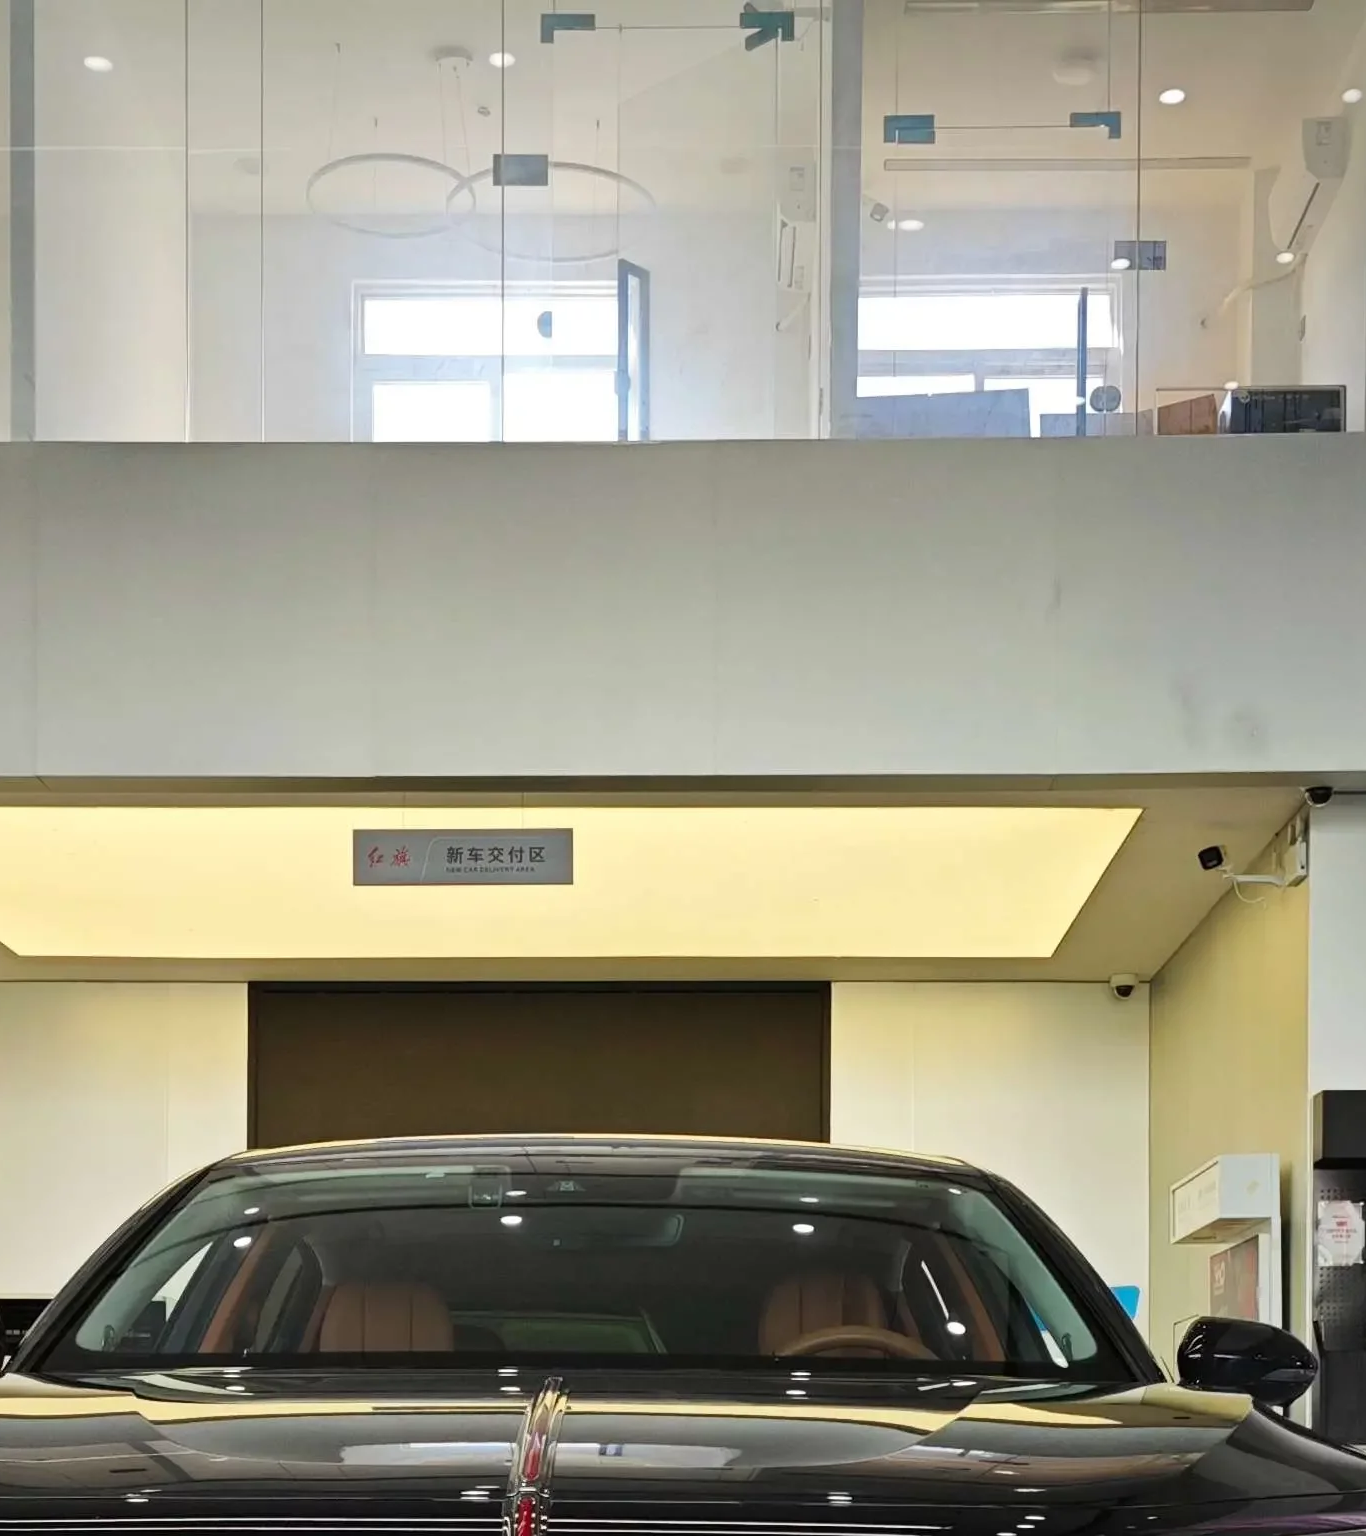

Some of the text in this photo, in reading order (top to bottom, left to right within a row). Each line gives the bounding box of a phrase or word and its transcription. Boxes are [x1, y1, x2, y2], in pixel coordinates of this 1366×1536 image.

[446, 846, 546, 865] 新车交付区
